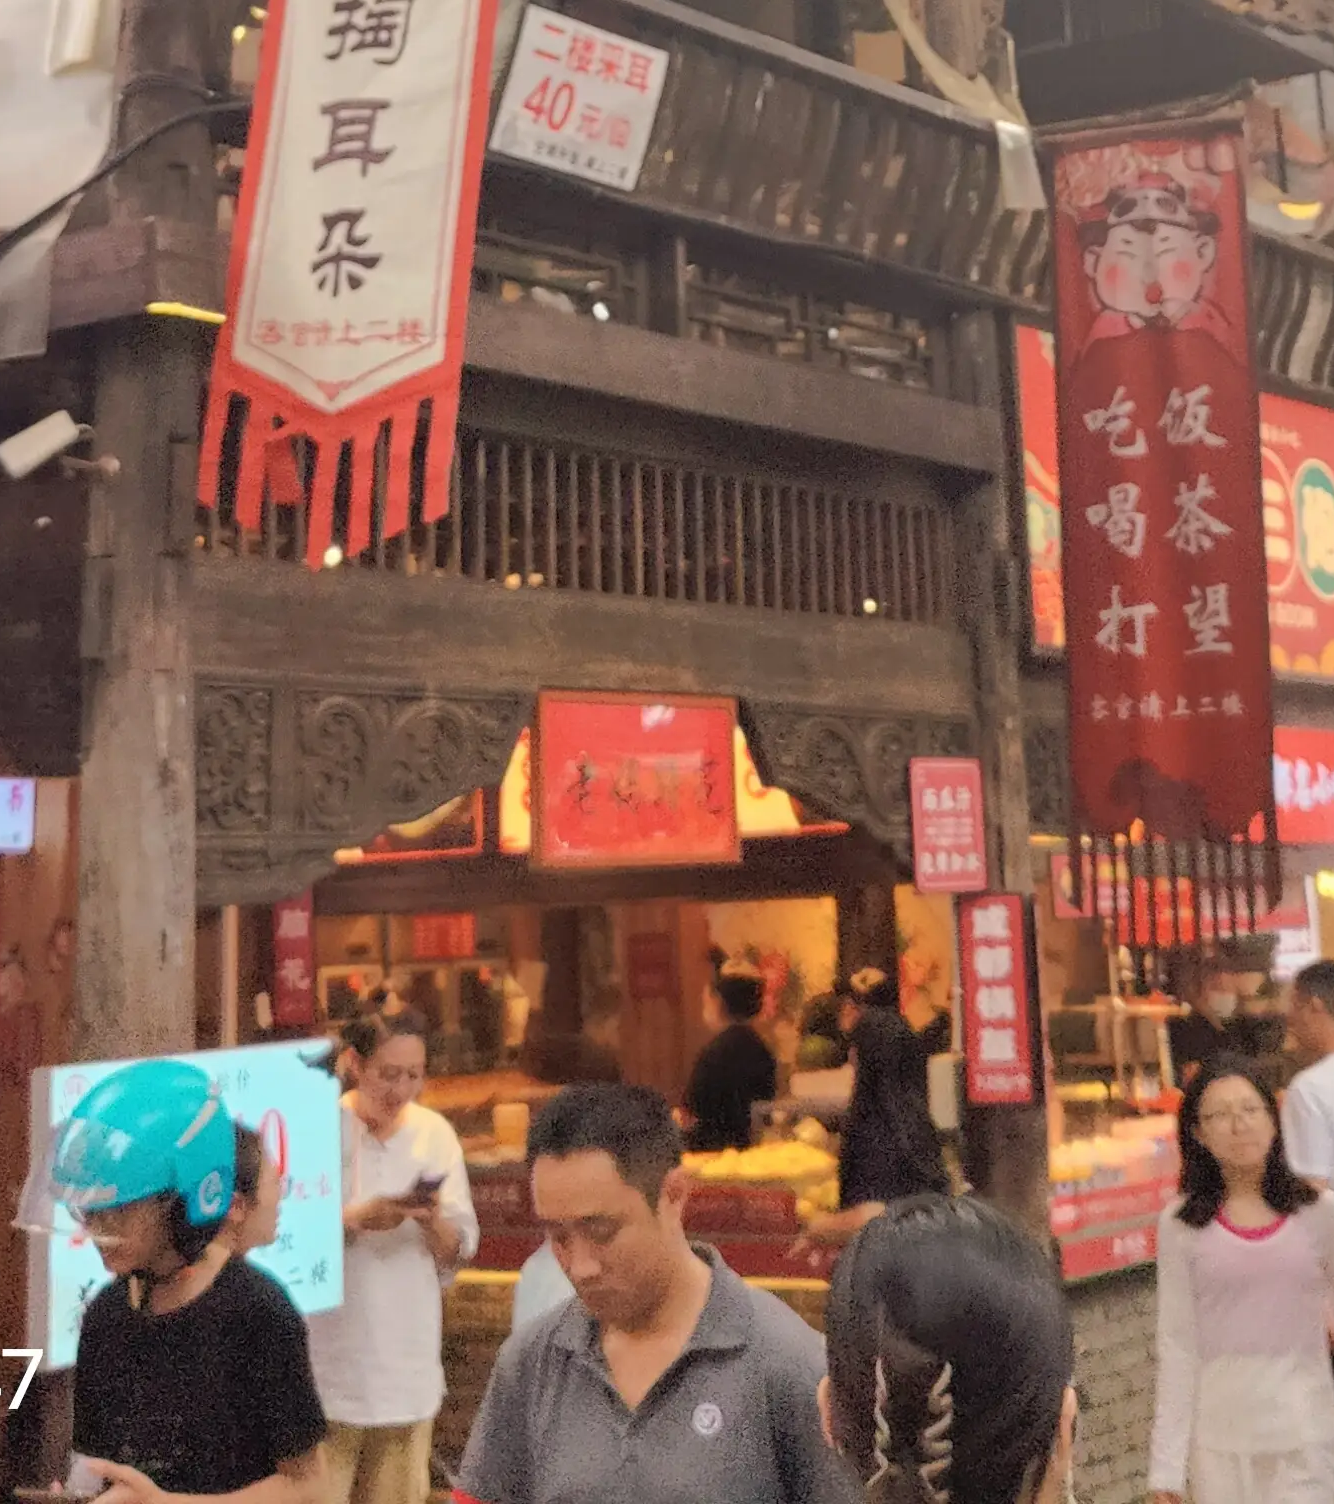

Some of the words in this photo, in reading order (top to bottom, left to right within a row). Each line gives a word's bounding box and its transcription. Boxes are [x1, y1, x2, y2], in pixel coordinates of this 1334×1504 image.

[1083, 382, 1228, 460] 吃饭
[1084, 479, 1234, 562] 喝茶
[1095, 581, 1235, 659] 打望
[197, 1170, 225, 1216] e
